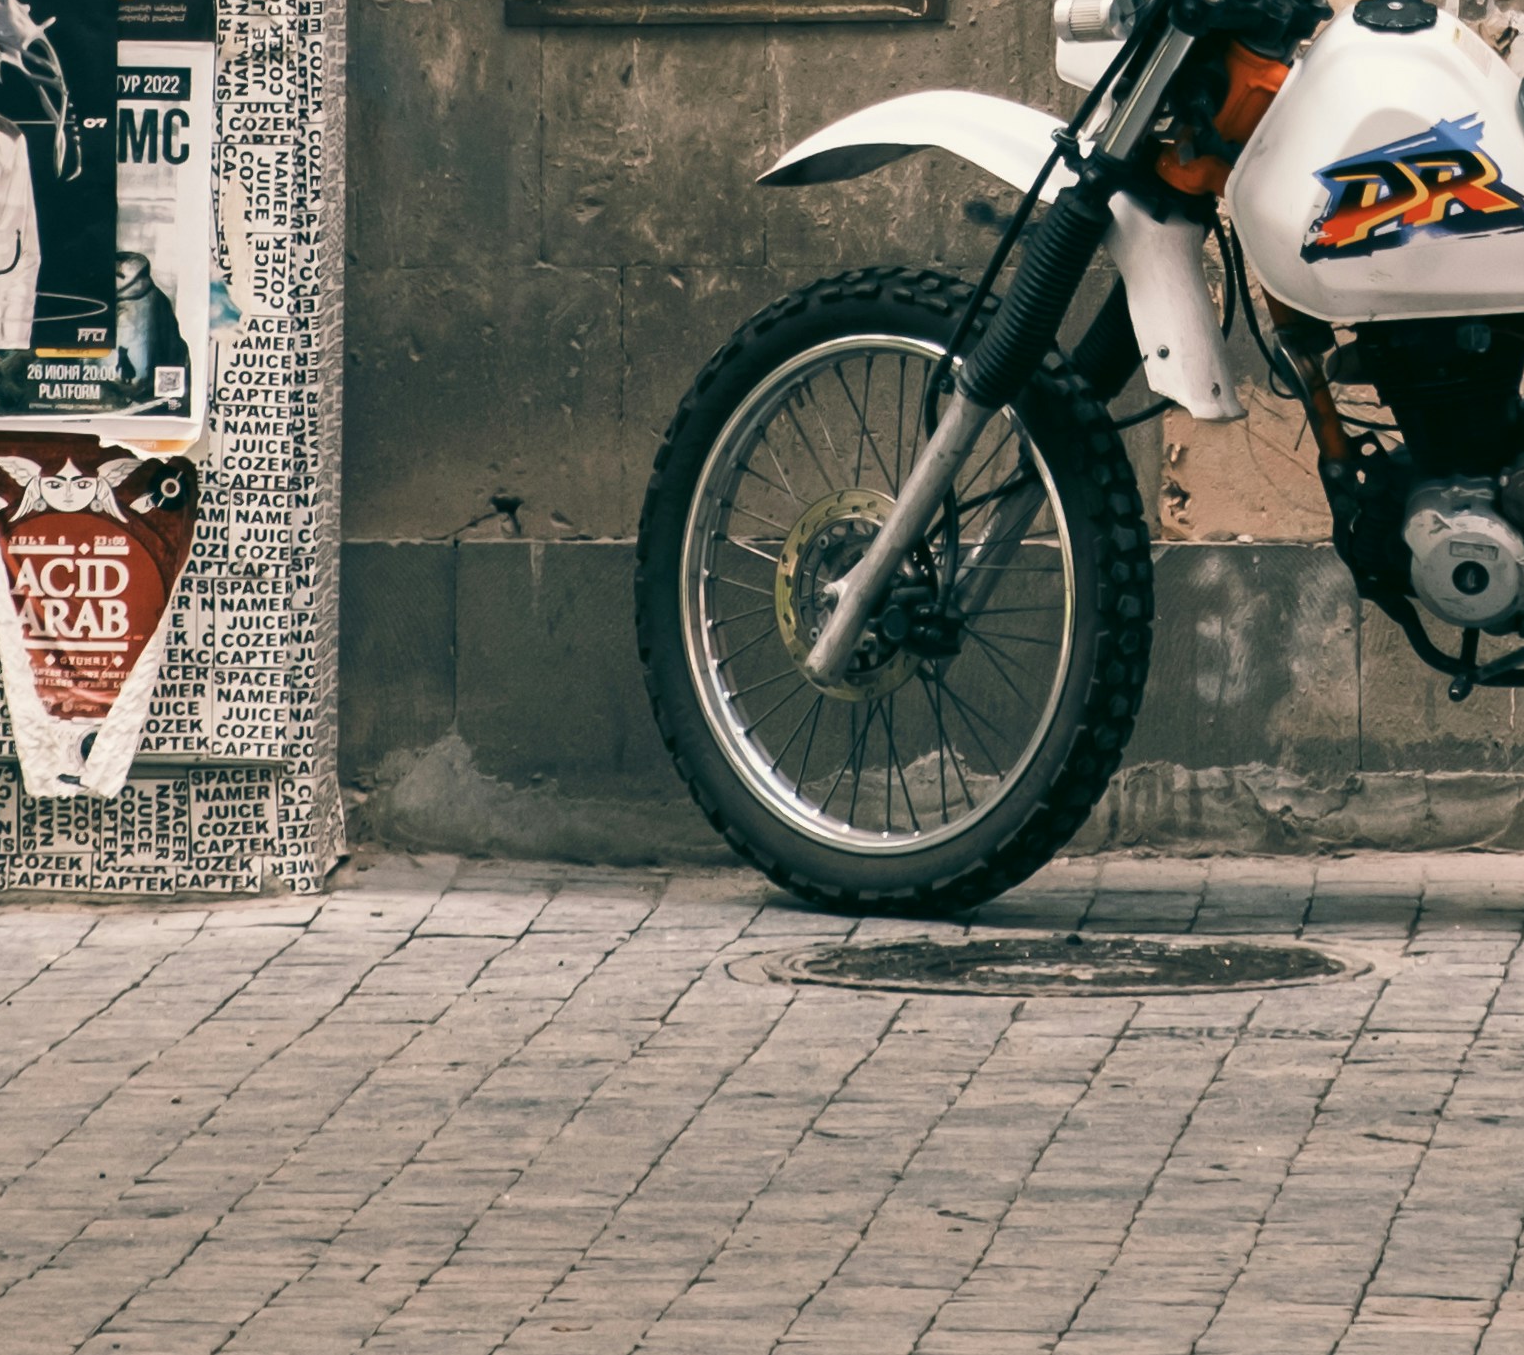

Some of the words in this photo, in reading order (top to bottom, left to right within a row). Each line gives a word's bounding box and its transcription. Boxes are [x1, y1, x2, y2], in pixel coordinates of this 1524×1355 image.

[144, 75, 179, 94] 2022
[83, 117, 108, 128] 07
[1316, 150, 1520, 248] DR
[27, 365, 42, 380] 26
[45, 365, 80, 380] ИЮНЯ
[39, 384, 100, 399] PLATFORM
[11, 558, 129, 598] ACID
[19, 599, 129, 638] ARAB
[191, 768, 272, 785] SPACER
[195, 786, 270, 802] NAMER
[202, 803, 265, 819] JUICE
[197, 821, 269, 837] COZEK
[193, 838, 276, 855] CAPTEK
